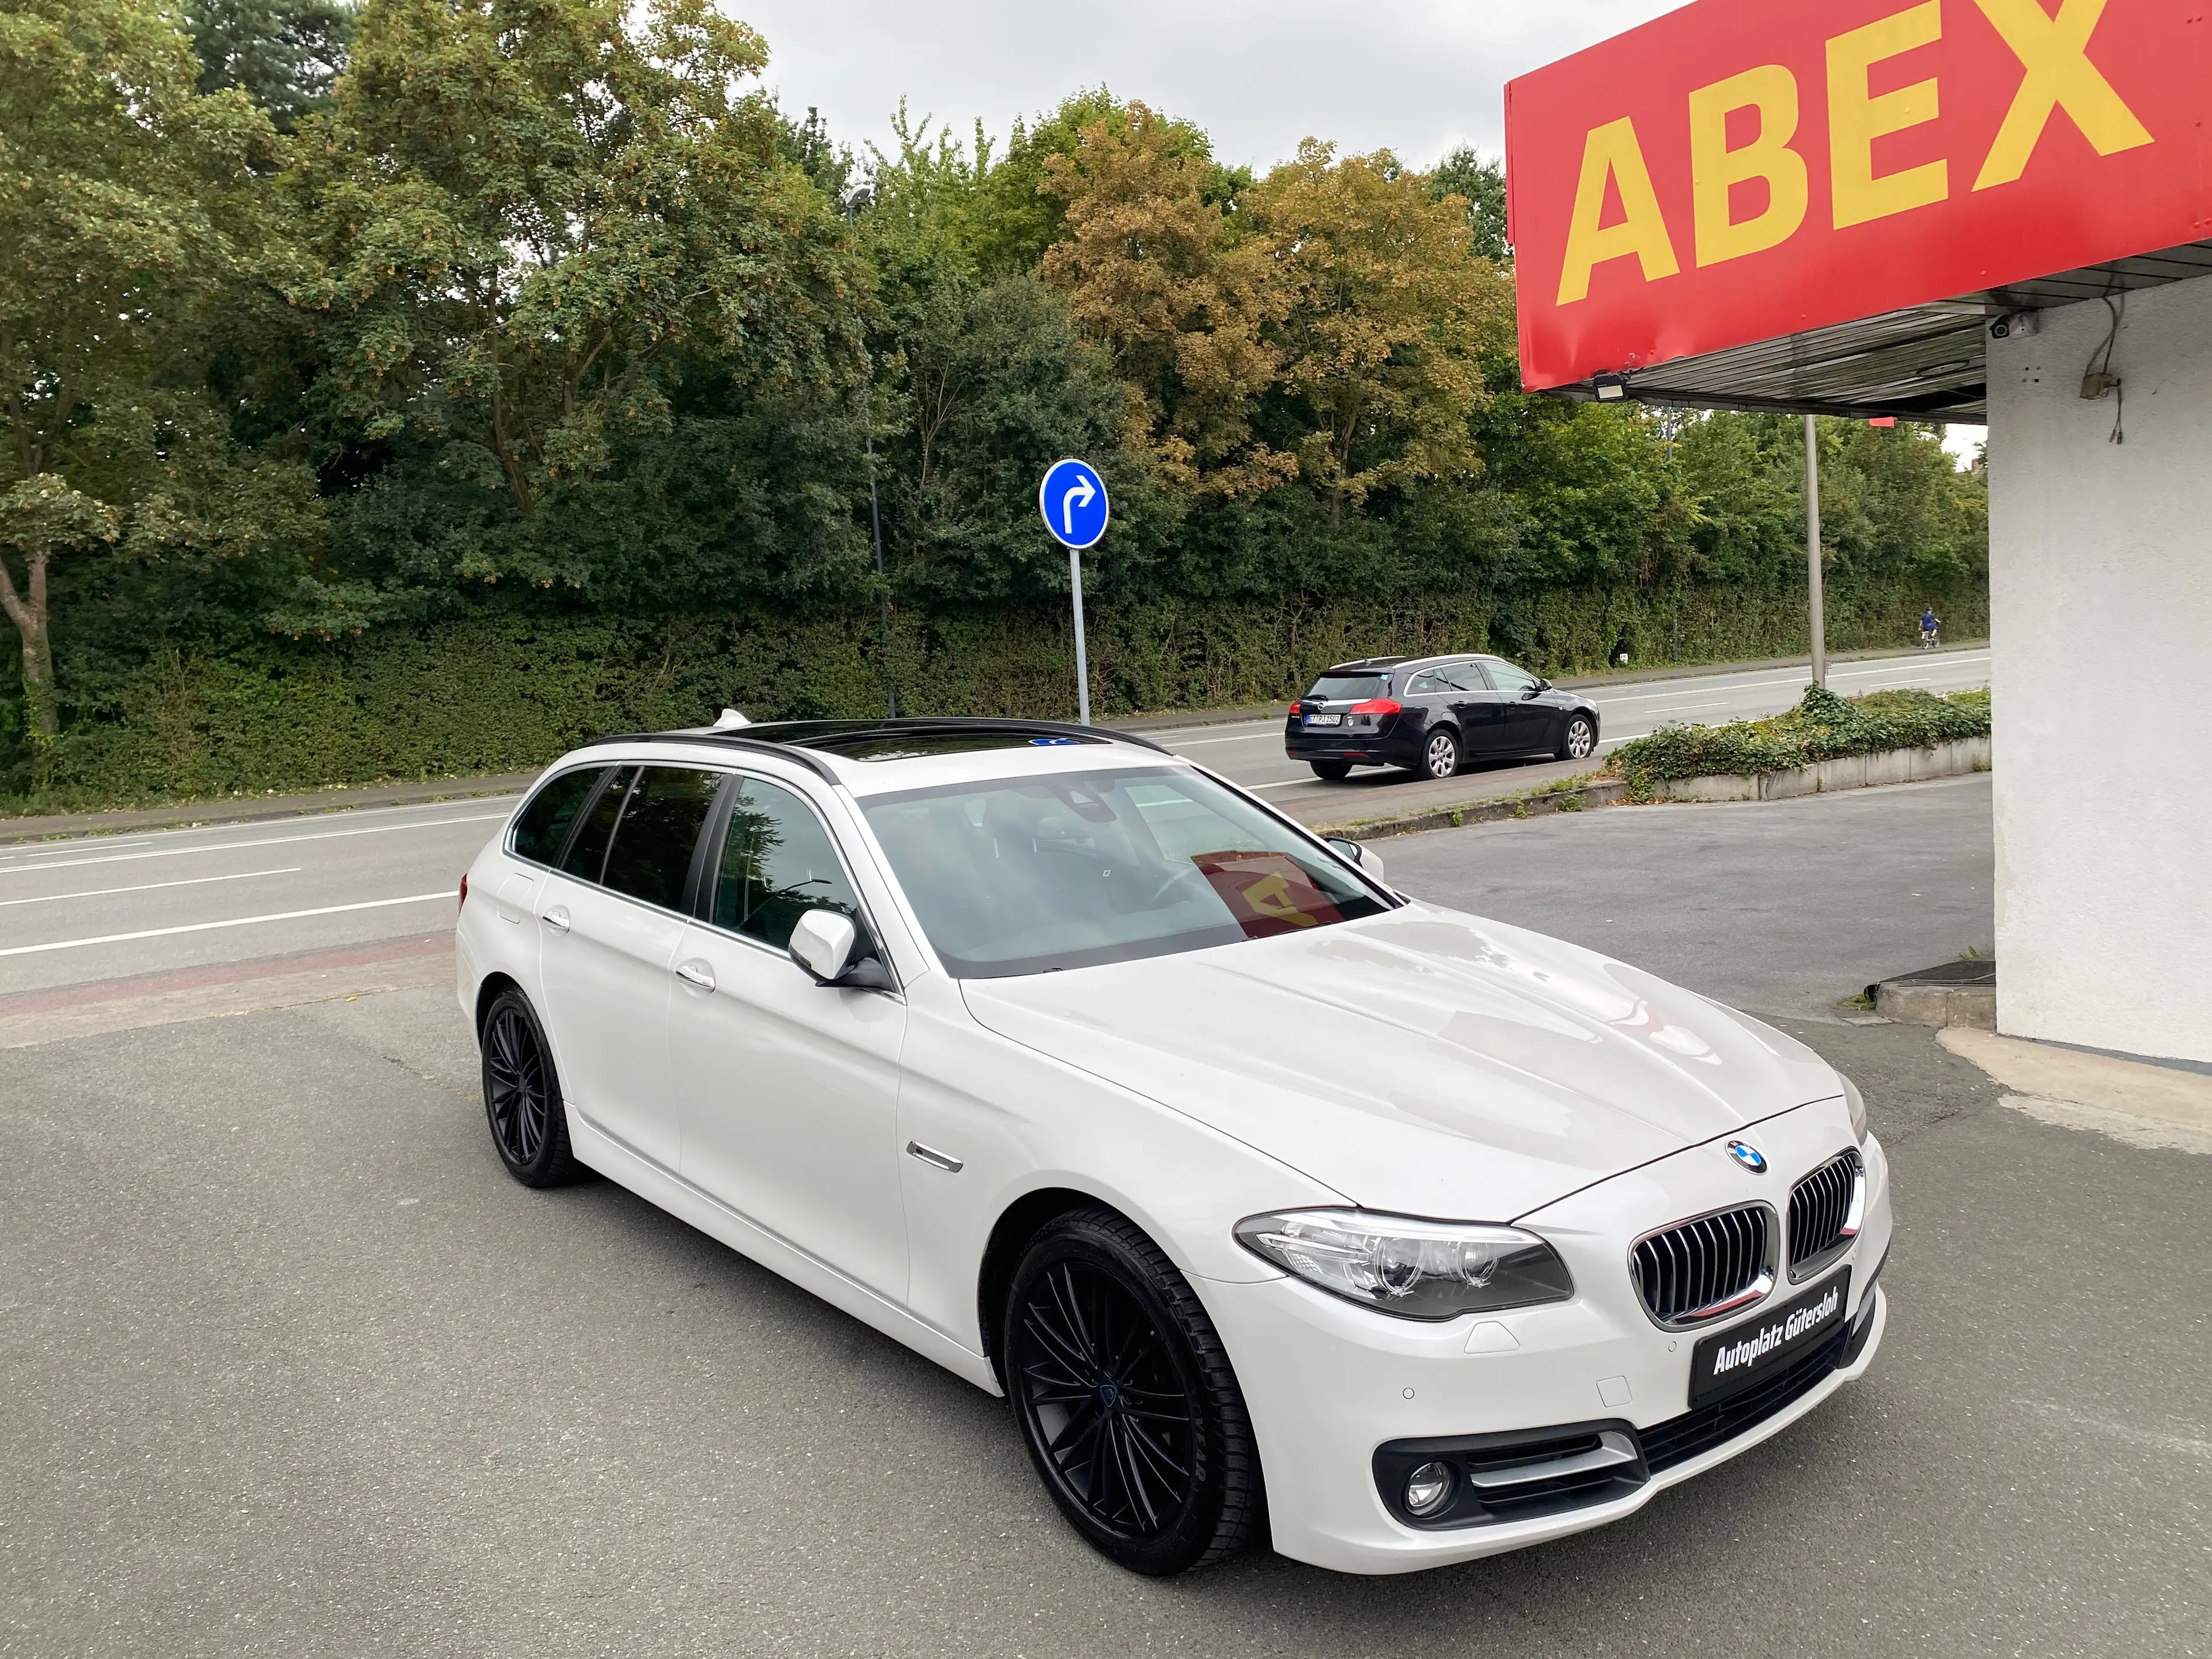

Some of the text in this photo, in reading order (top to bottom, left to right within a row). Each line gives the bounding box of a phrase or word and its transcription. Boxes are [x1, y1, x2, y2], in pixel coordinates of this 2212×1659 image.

[1556, 0, 2154, 306] ABEX
[1713, 1285, 1839, 1376] Autoplatz Gütersloh
